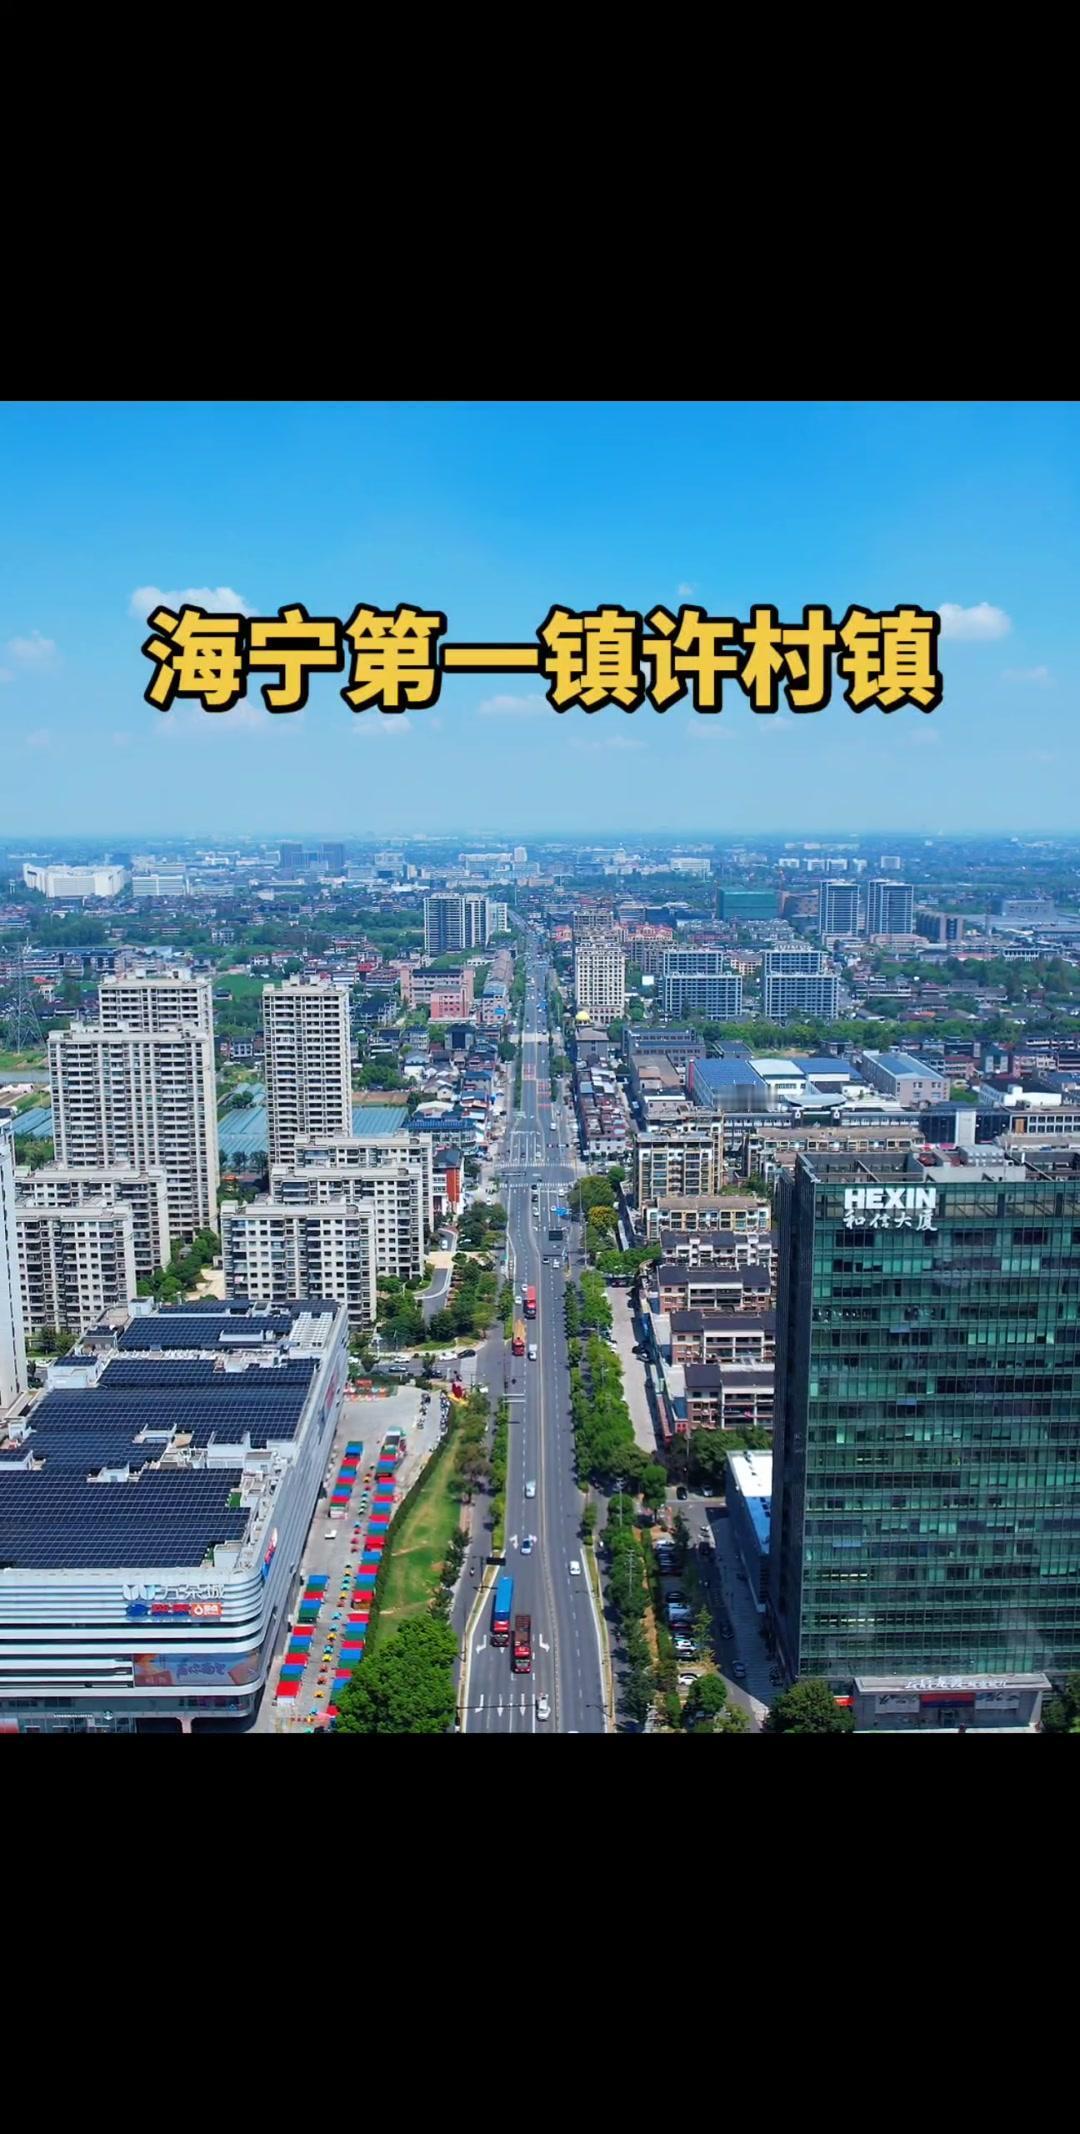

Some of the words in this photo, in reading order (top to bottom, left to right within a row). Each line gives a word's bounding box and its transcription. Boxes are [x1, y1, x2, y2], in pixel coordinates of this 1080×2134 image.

[844, 1188, 937, 1209] HEXIN
[843, 1209, 938, 1231] 和信大厦
